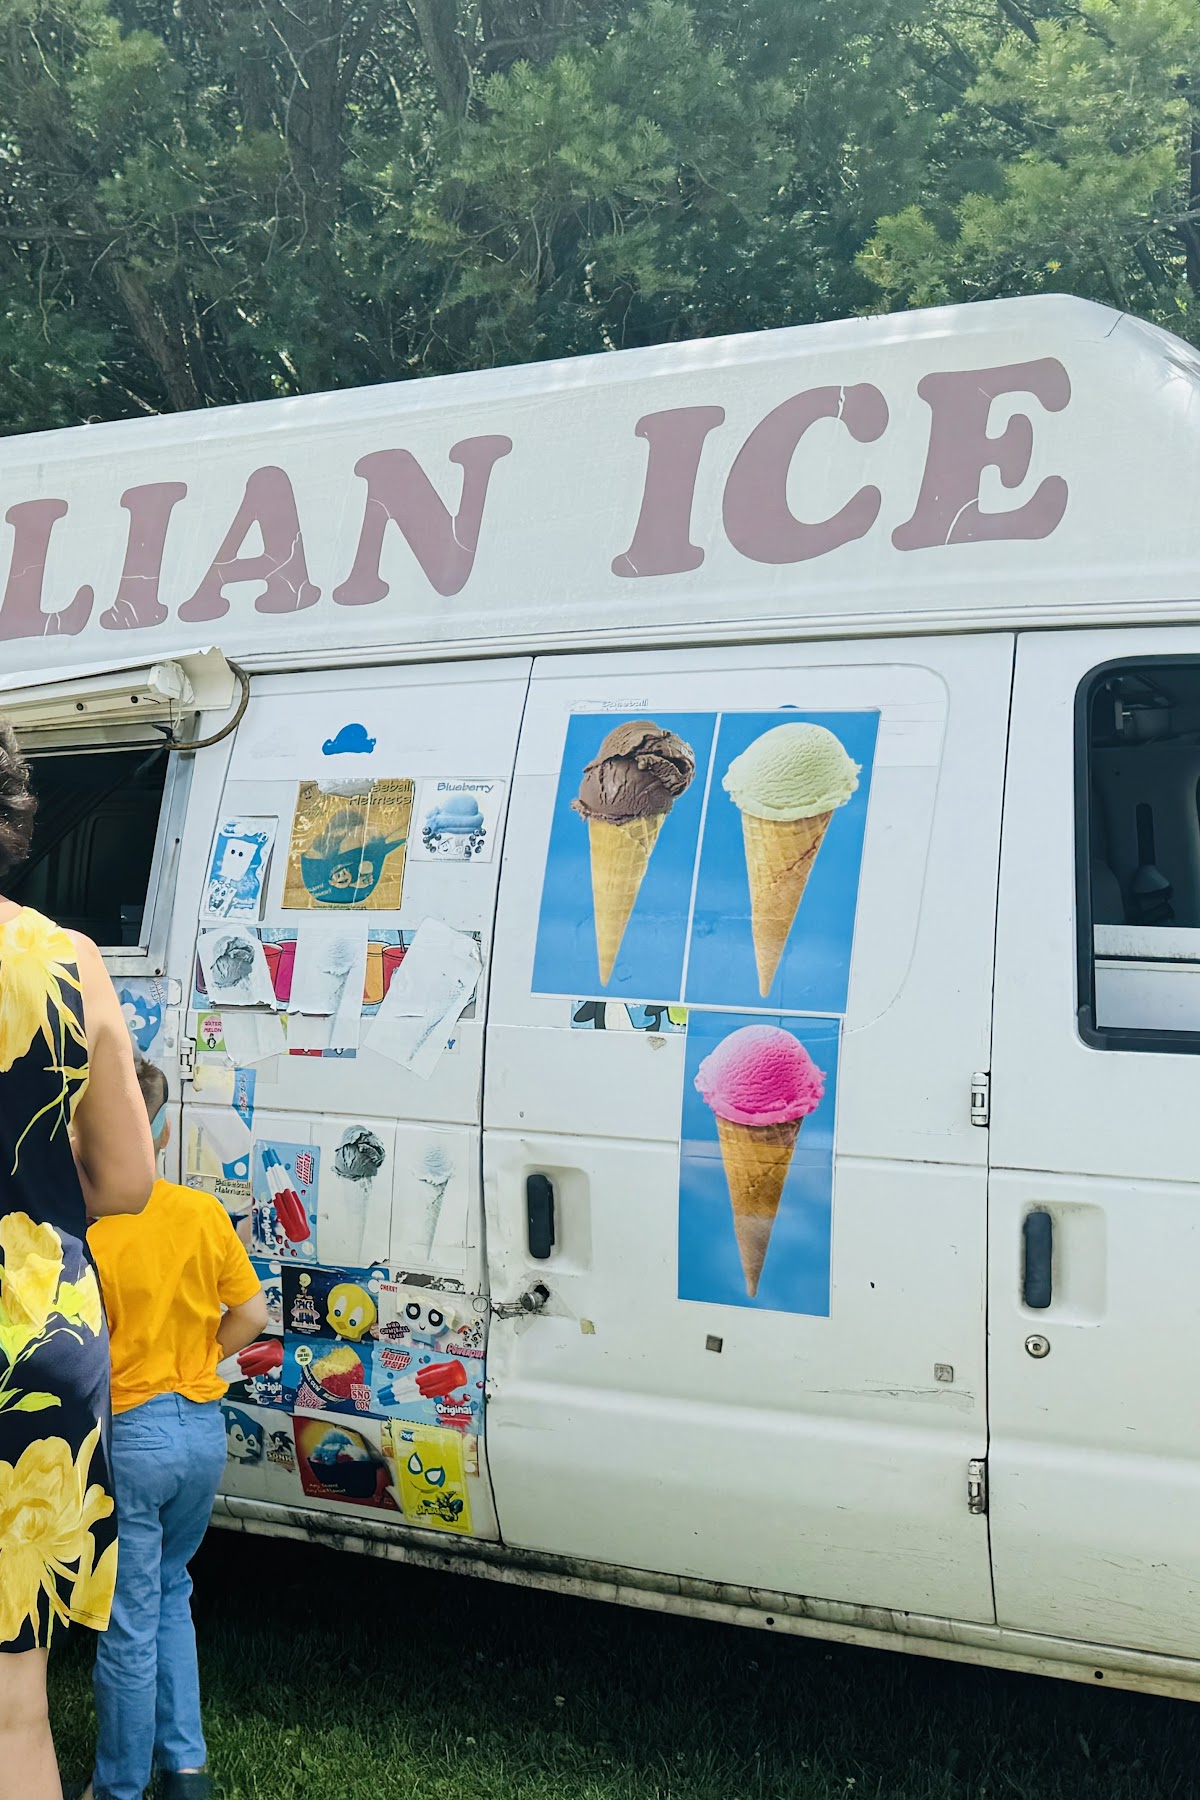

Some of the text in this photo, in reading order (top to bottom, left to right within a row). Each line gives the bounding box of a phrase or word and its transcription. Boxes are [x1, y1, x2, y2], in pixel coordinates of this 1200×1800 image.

[611, 357, 1072, 578] ICE
[437, 782, 494, 793] Blueberry
[381, 1351, 411, 1364] BOMB
[382, 1360, 406, 1370] POP
[351, 1389, 370, 1399] SNO
[436, 1403, 473, 1416] Original
